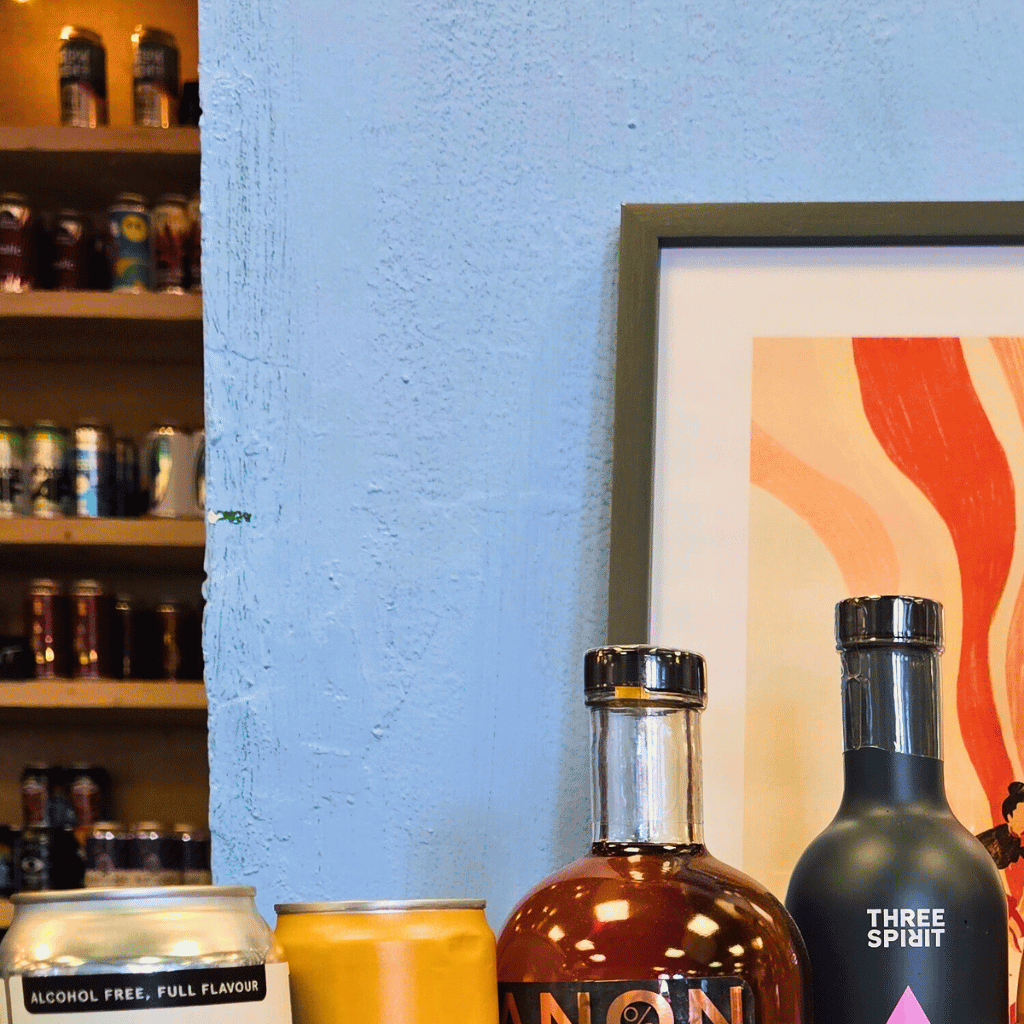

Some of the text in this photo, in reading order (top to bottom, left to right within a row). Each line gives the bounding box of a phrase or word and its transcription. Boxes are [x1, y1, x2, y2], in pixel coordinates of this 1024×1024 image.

[867, 908, 945, 927] THREE
[867, 928, 945, 948] SPIRIT
[31, 980, 259, 1005] ALCOHOL FREE, FULL FLAVOUR
